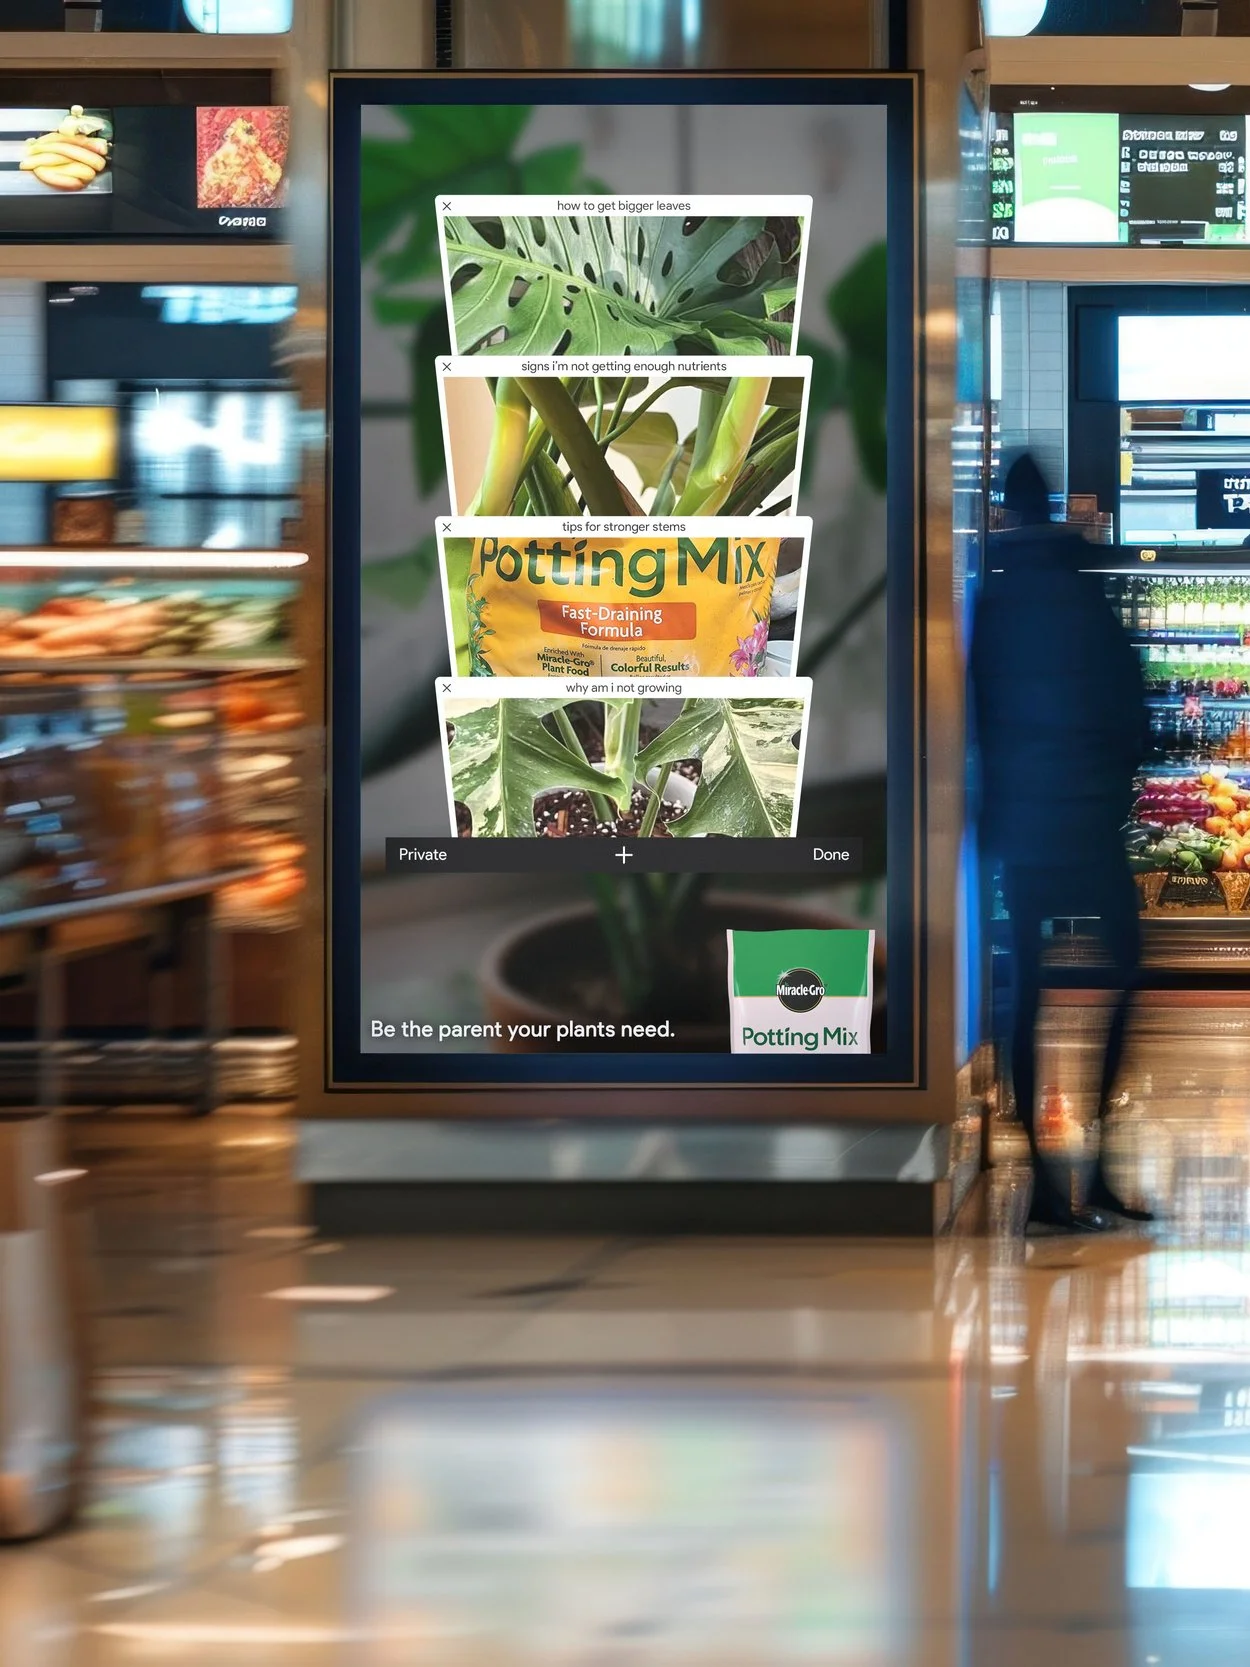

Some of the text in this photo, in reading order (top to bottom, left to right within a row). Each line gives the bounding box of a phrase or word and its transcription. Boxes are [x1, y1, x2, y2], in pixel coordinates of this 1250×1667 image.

[557, 200, 691, 214] how to get bigger leaves
[521, 360, 550, 374] signs
[571, 361, 590, 372] not
[591, 360, 631, 374] getting
[633, 360, 675, 374] enough
[677, 360, 727, 372] nutrients
[562, 521, 686, 535] tips for stronger stems
[480, 537, 766, 597] Potting Mix
[561, 604, 663, 625] Fast-Draining
[580, 621, 644, 638] Formula
[543, 646, 585, 658] Enriched With
[542, 662, 565, 673] Plant
[566, 665, 589, 677] Food
[610, 661, 690, 673] Colorful Results
[565, 682, 589, 695] why
[591, 684, 609, 693] am
[616, 683, 635, 693] not
[637, 682, 682, 696] growing
[399, 847, 448, 861] Private
[813, 847, 850, 861] Done
[371, 1020, 675, 1042] Be the parent your plants need.
[742, 1027, 859, 1051] Potting Mix
